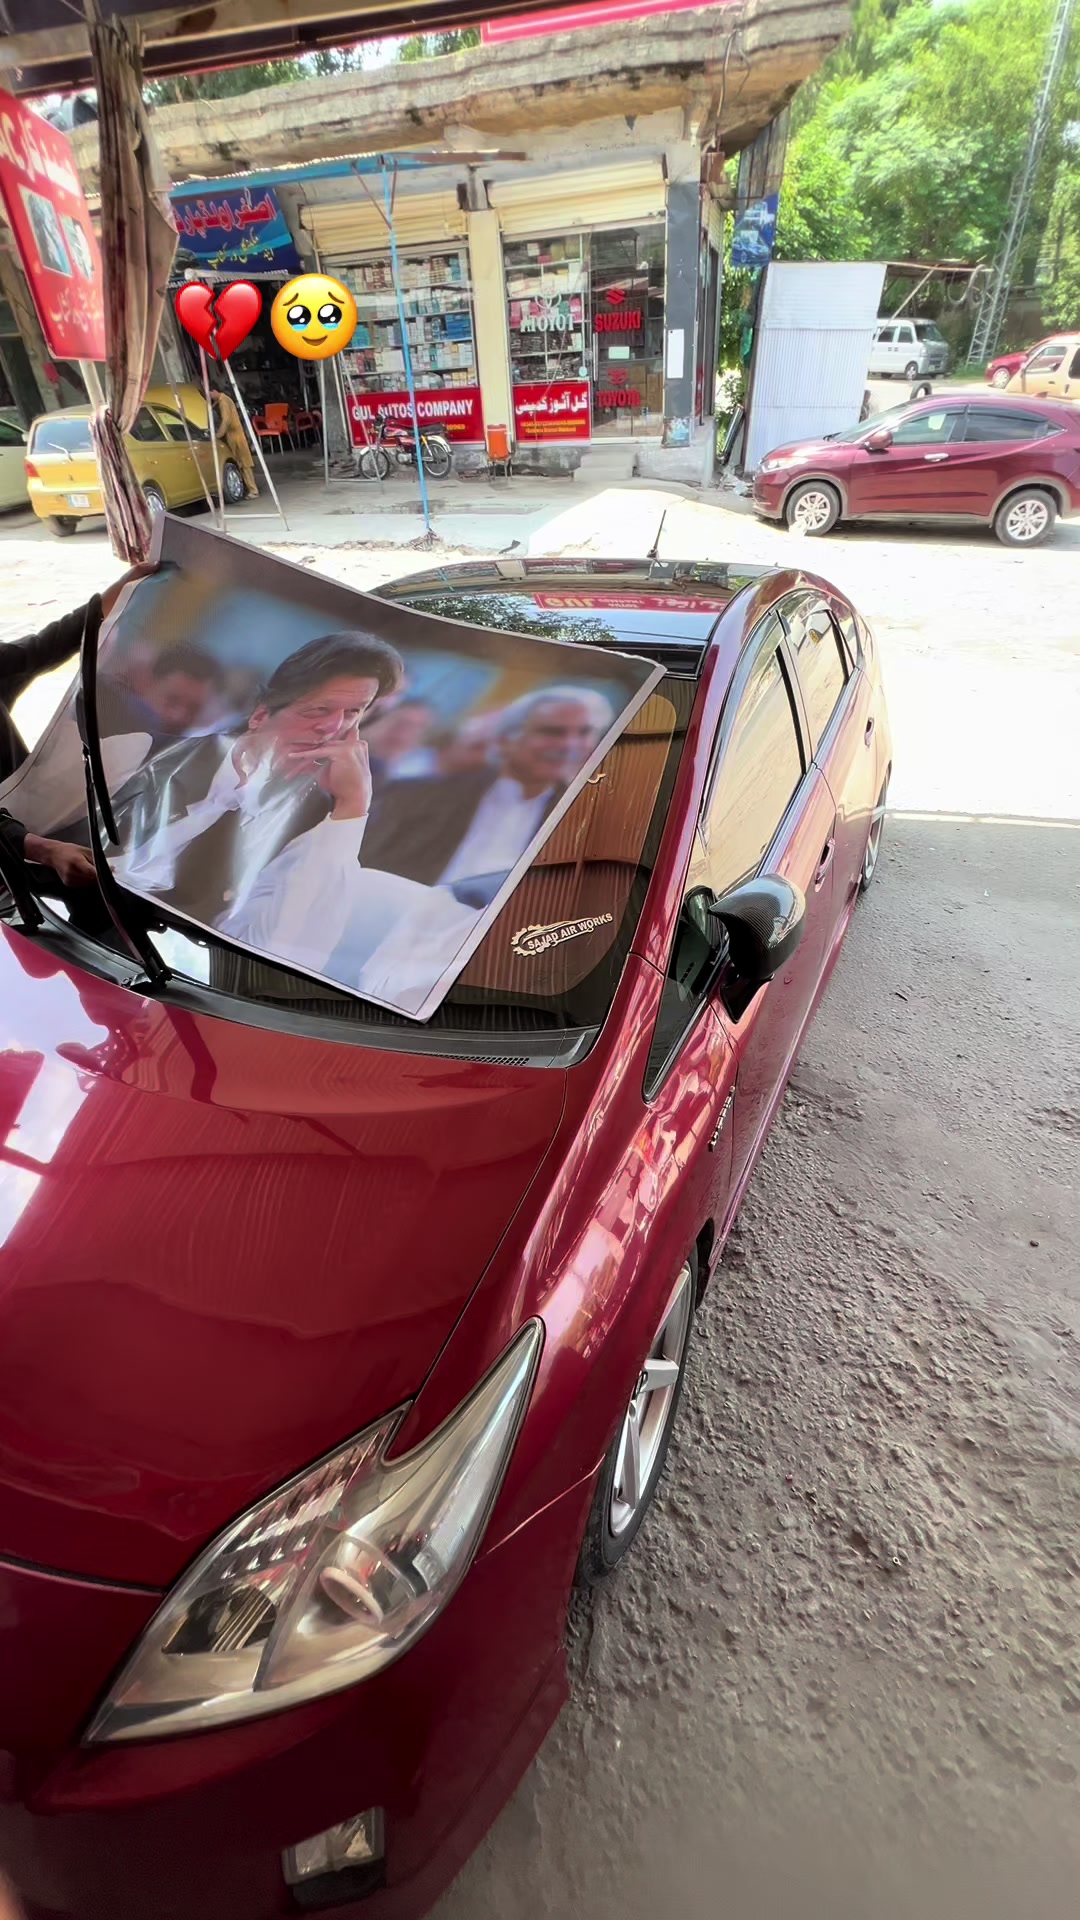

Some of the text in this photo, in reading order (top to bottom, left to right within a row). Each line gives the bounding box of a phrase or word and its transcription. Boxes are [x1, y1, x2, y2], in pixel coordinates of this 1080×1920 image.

[595, 311, 642, 333] SUZUKI
[571, 391, 588, 413] گل
[597, 389, 640, 407] TOYOTA
[352, 400, 473, 421] GUL AUTOS COMPANY
[527, 912, 613, 950] SAJAD AIR WORKS
